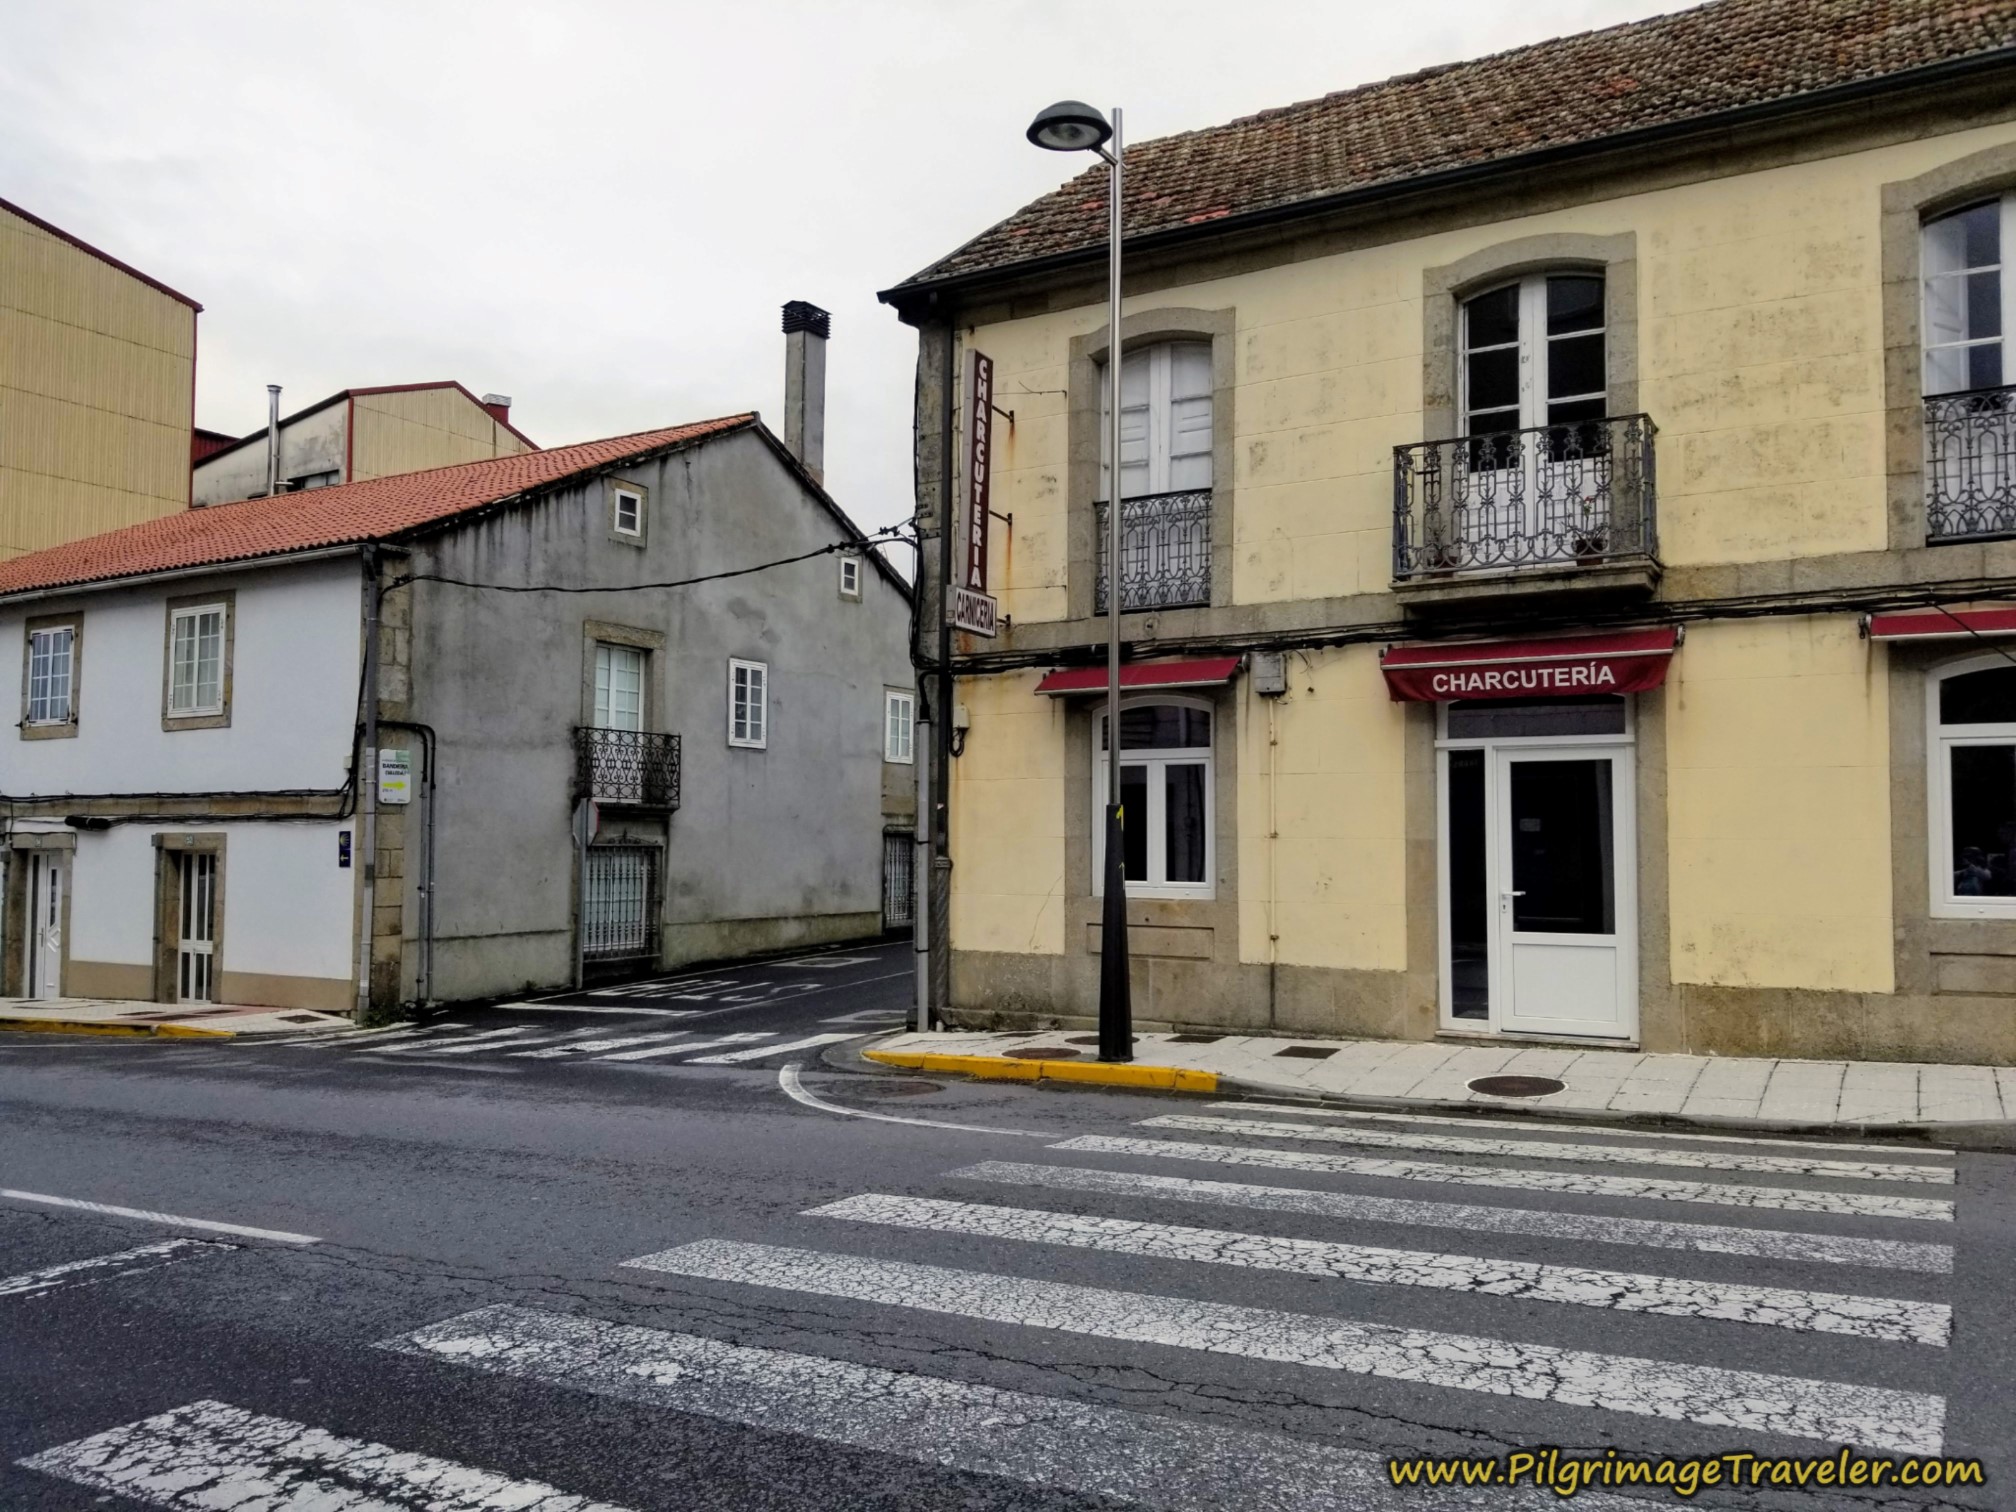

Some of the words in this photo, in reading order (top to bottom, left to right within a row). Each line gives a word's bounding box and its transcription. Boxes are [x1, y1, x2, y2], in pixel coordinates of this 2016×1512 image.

[971, 359, 988, 588] CHARCUTERIA
[957, 591, 994, 631] CARNICERIA
[1432, 662, 1615, 692] CHARCUTERÍA
